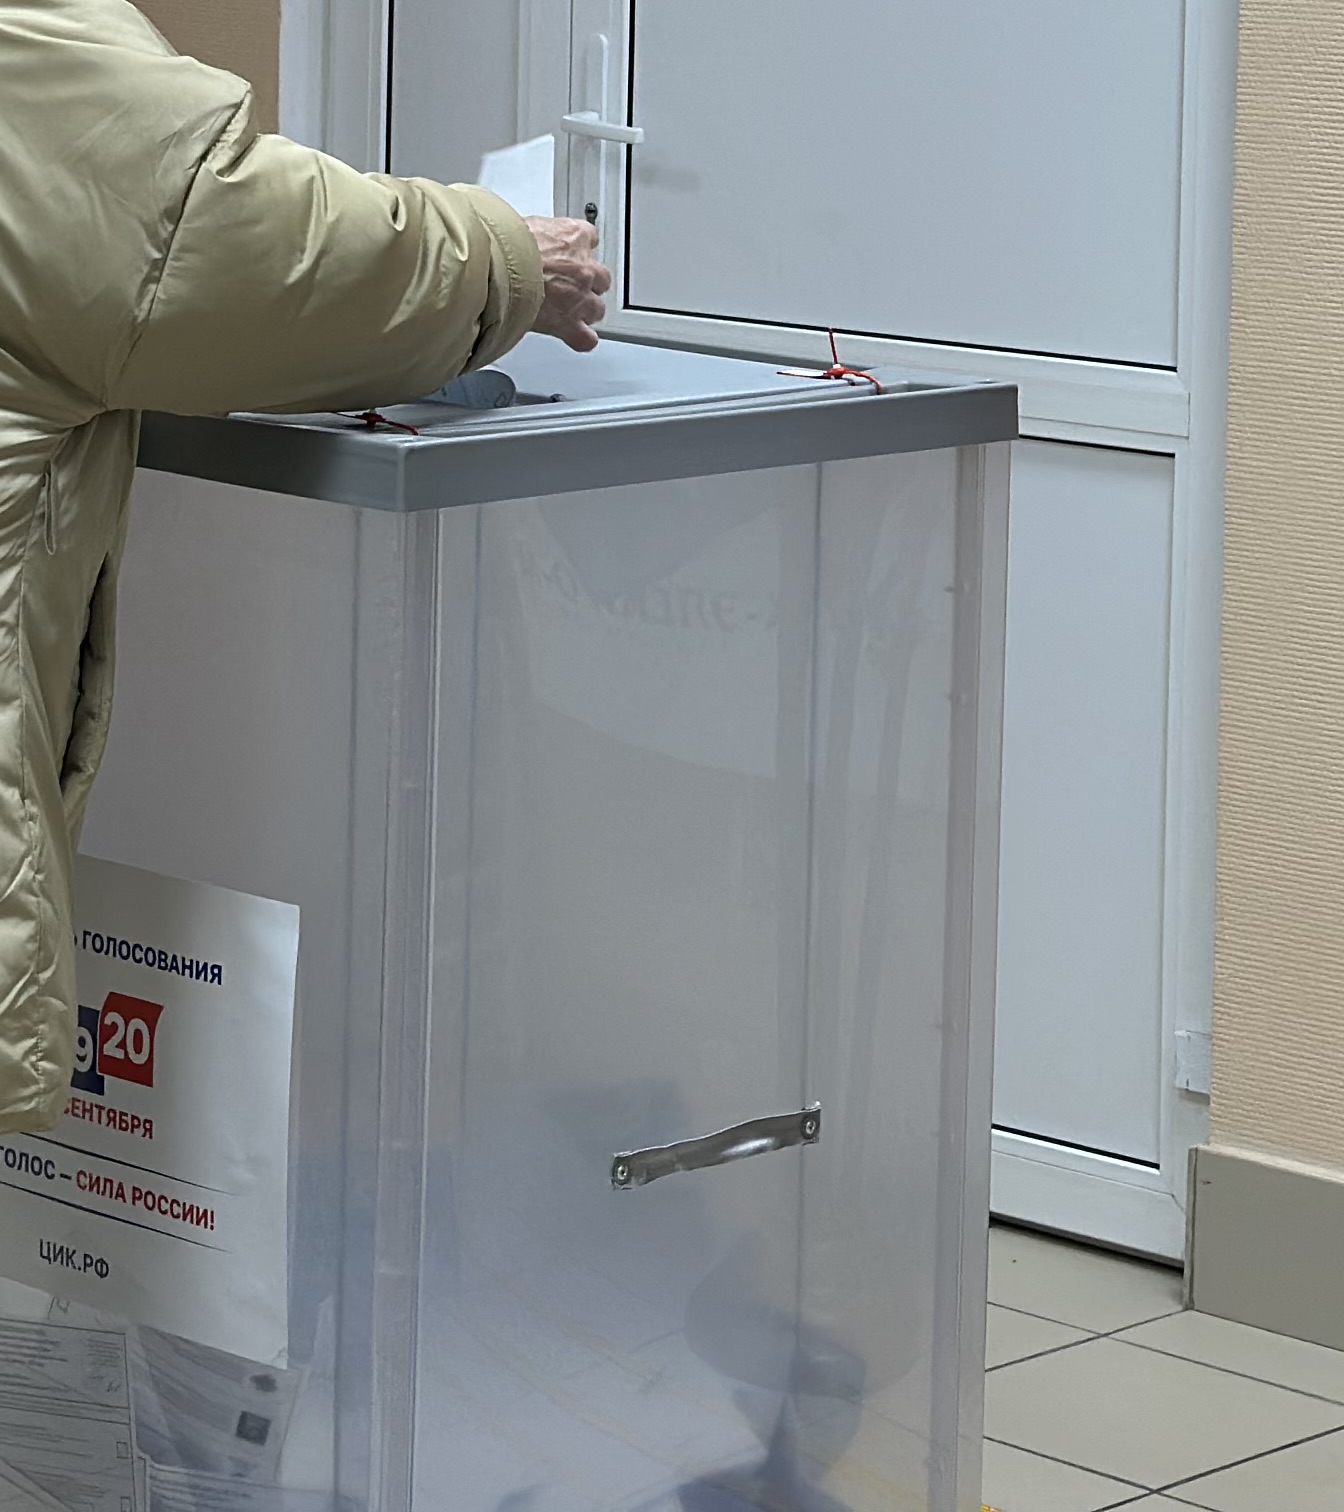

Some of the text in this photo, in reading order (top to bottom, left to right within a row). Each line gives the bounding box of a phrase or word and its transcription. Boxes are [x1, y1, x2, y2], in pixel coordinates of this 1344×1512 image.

[81, 930, 223, 986] ГОЛОСОВАНИЯ
[74, 1011, 150, 1074] 9 20
[76, 1169, 127, 1203] СИЛА
[131, 1185, 216, 1231] РОССИИ!
[39, 1238, 110, 1279] ЦИК.РФ
